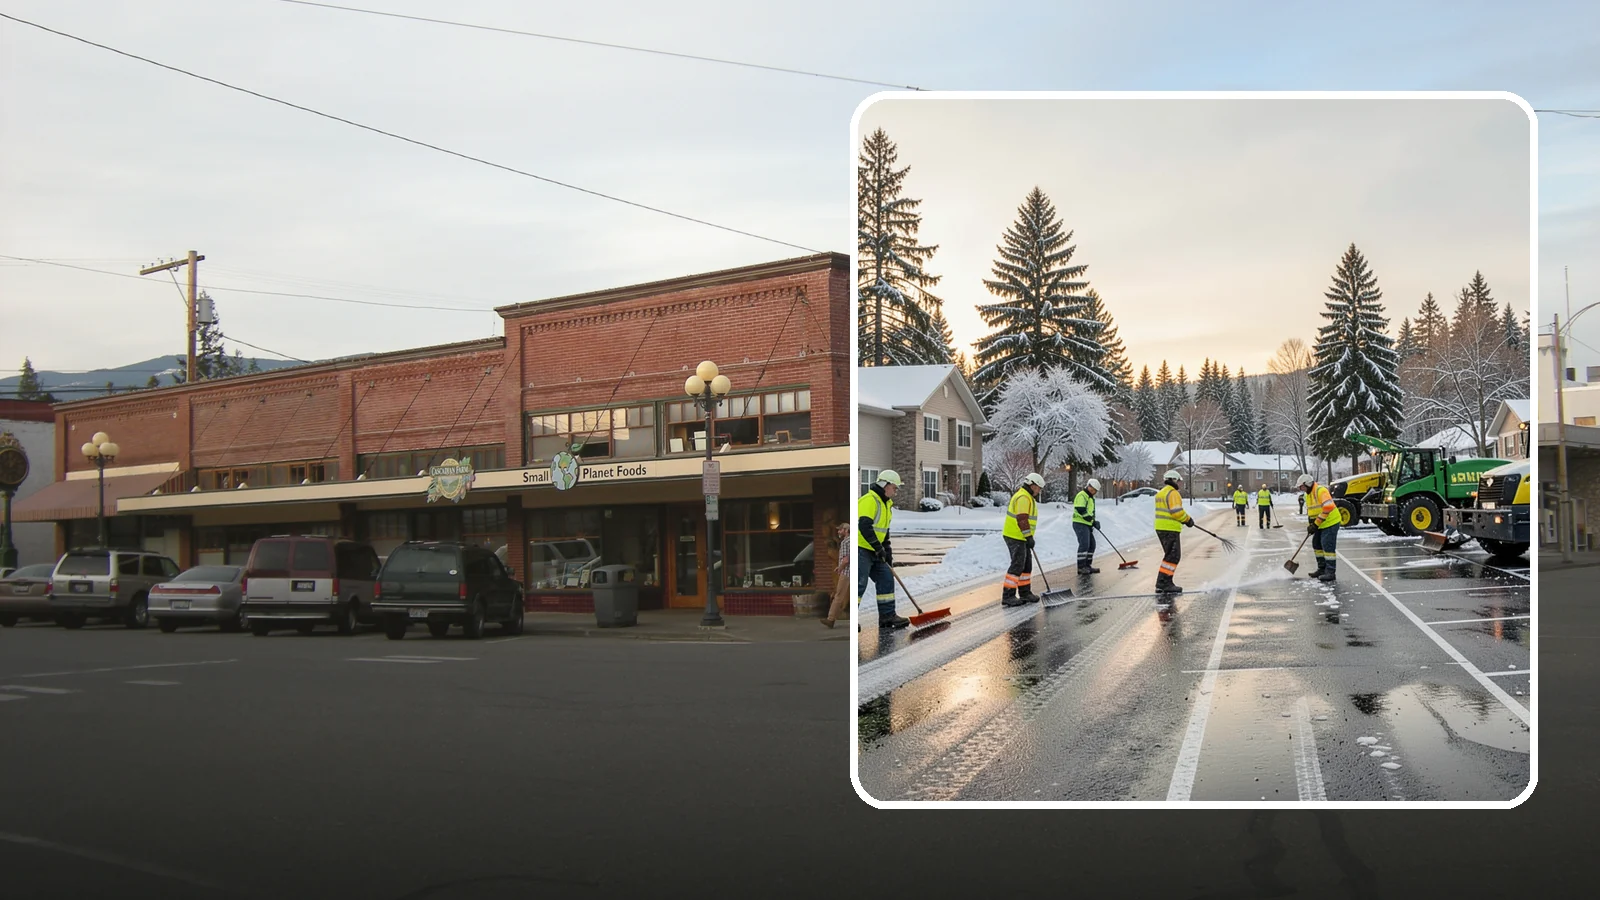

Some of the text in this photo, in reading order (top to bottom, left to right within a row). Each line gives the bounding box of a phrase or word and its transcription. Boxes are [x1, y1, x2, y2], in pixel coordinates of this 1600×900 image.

[523, 464, 647, 483] Small Planet Foods
